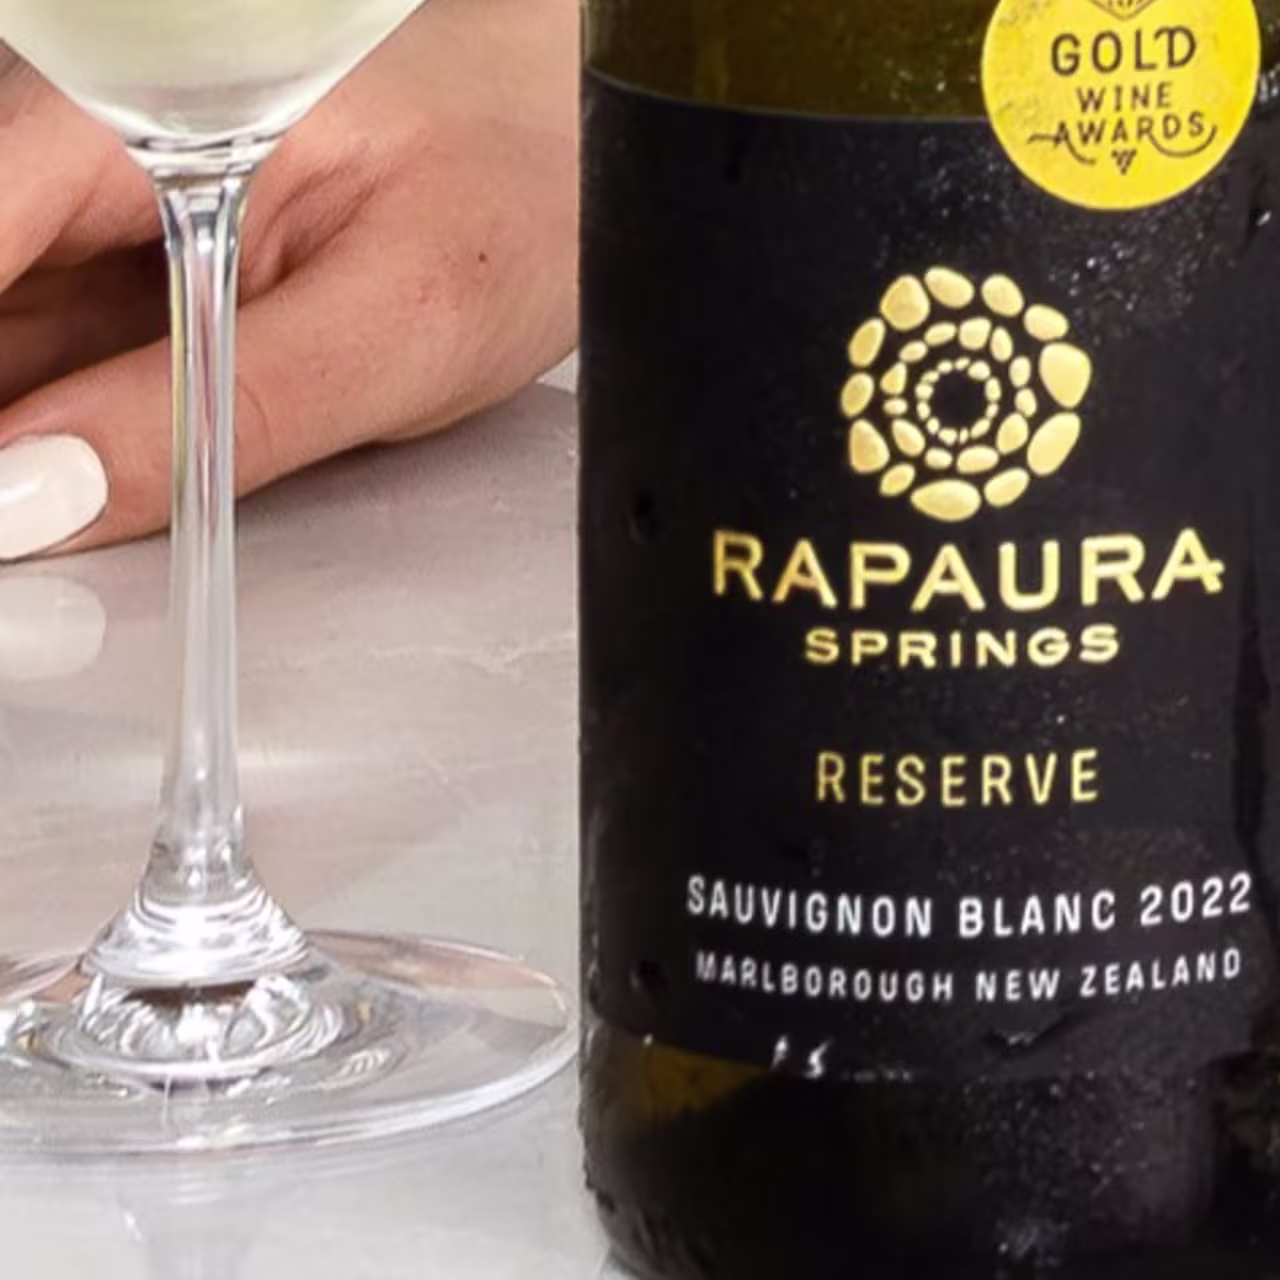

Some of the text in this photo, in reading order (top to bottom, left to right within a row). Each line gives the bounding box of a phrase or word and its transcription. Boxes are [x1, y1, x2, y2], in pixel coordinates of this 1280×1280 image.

[1050, 25, 1198, 77] GOLD
[1076, 81, 1174, 114] WINE
[1029, 111, 1217, 159] AWARDS
[711, 527, 1226, 612] RAPAURA
[805, 623, 1121, 670] SPRINGS
[816, 747, 1099, 808] RESERVE
[686, 870, 1253, 940] SAUVIGNON BLANC 2022
[696, 945, 1243, 1004] MARLBOROUGH NEW ZEALAND
